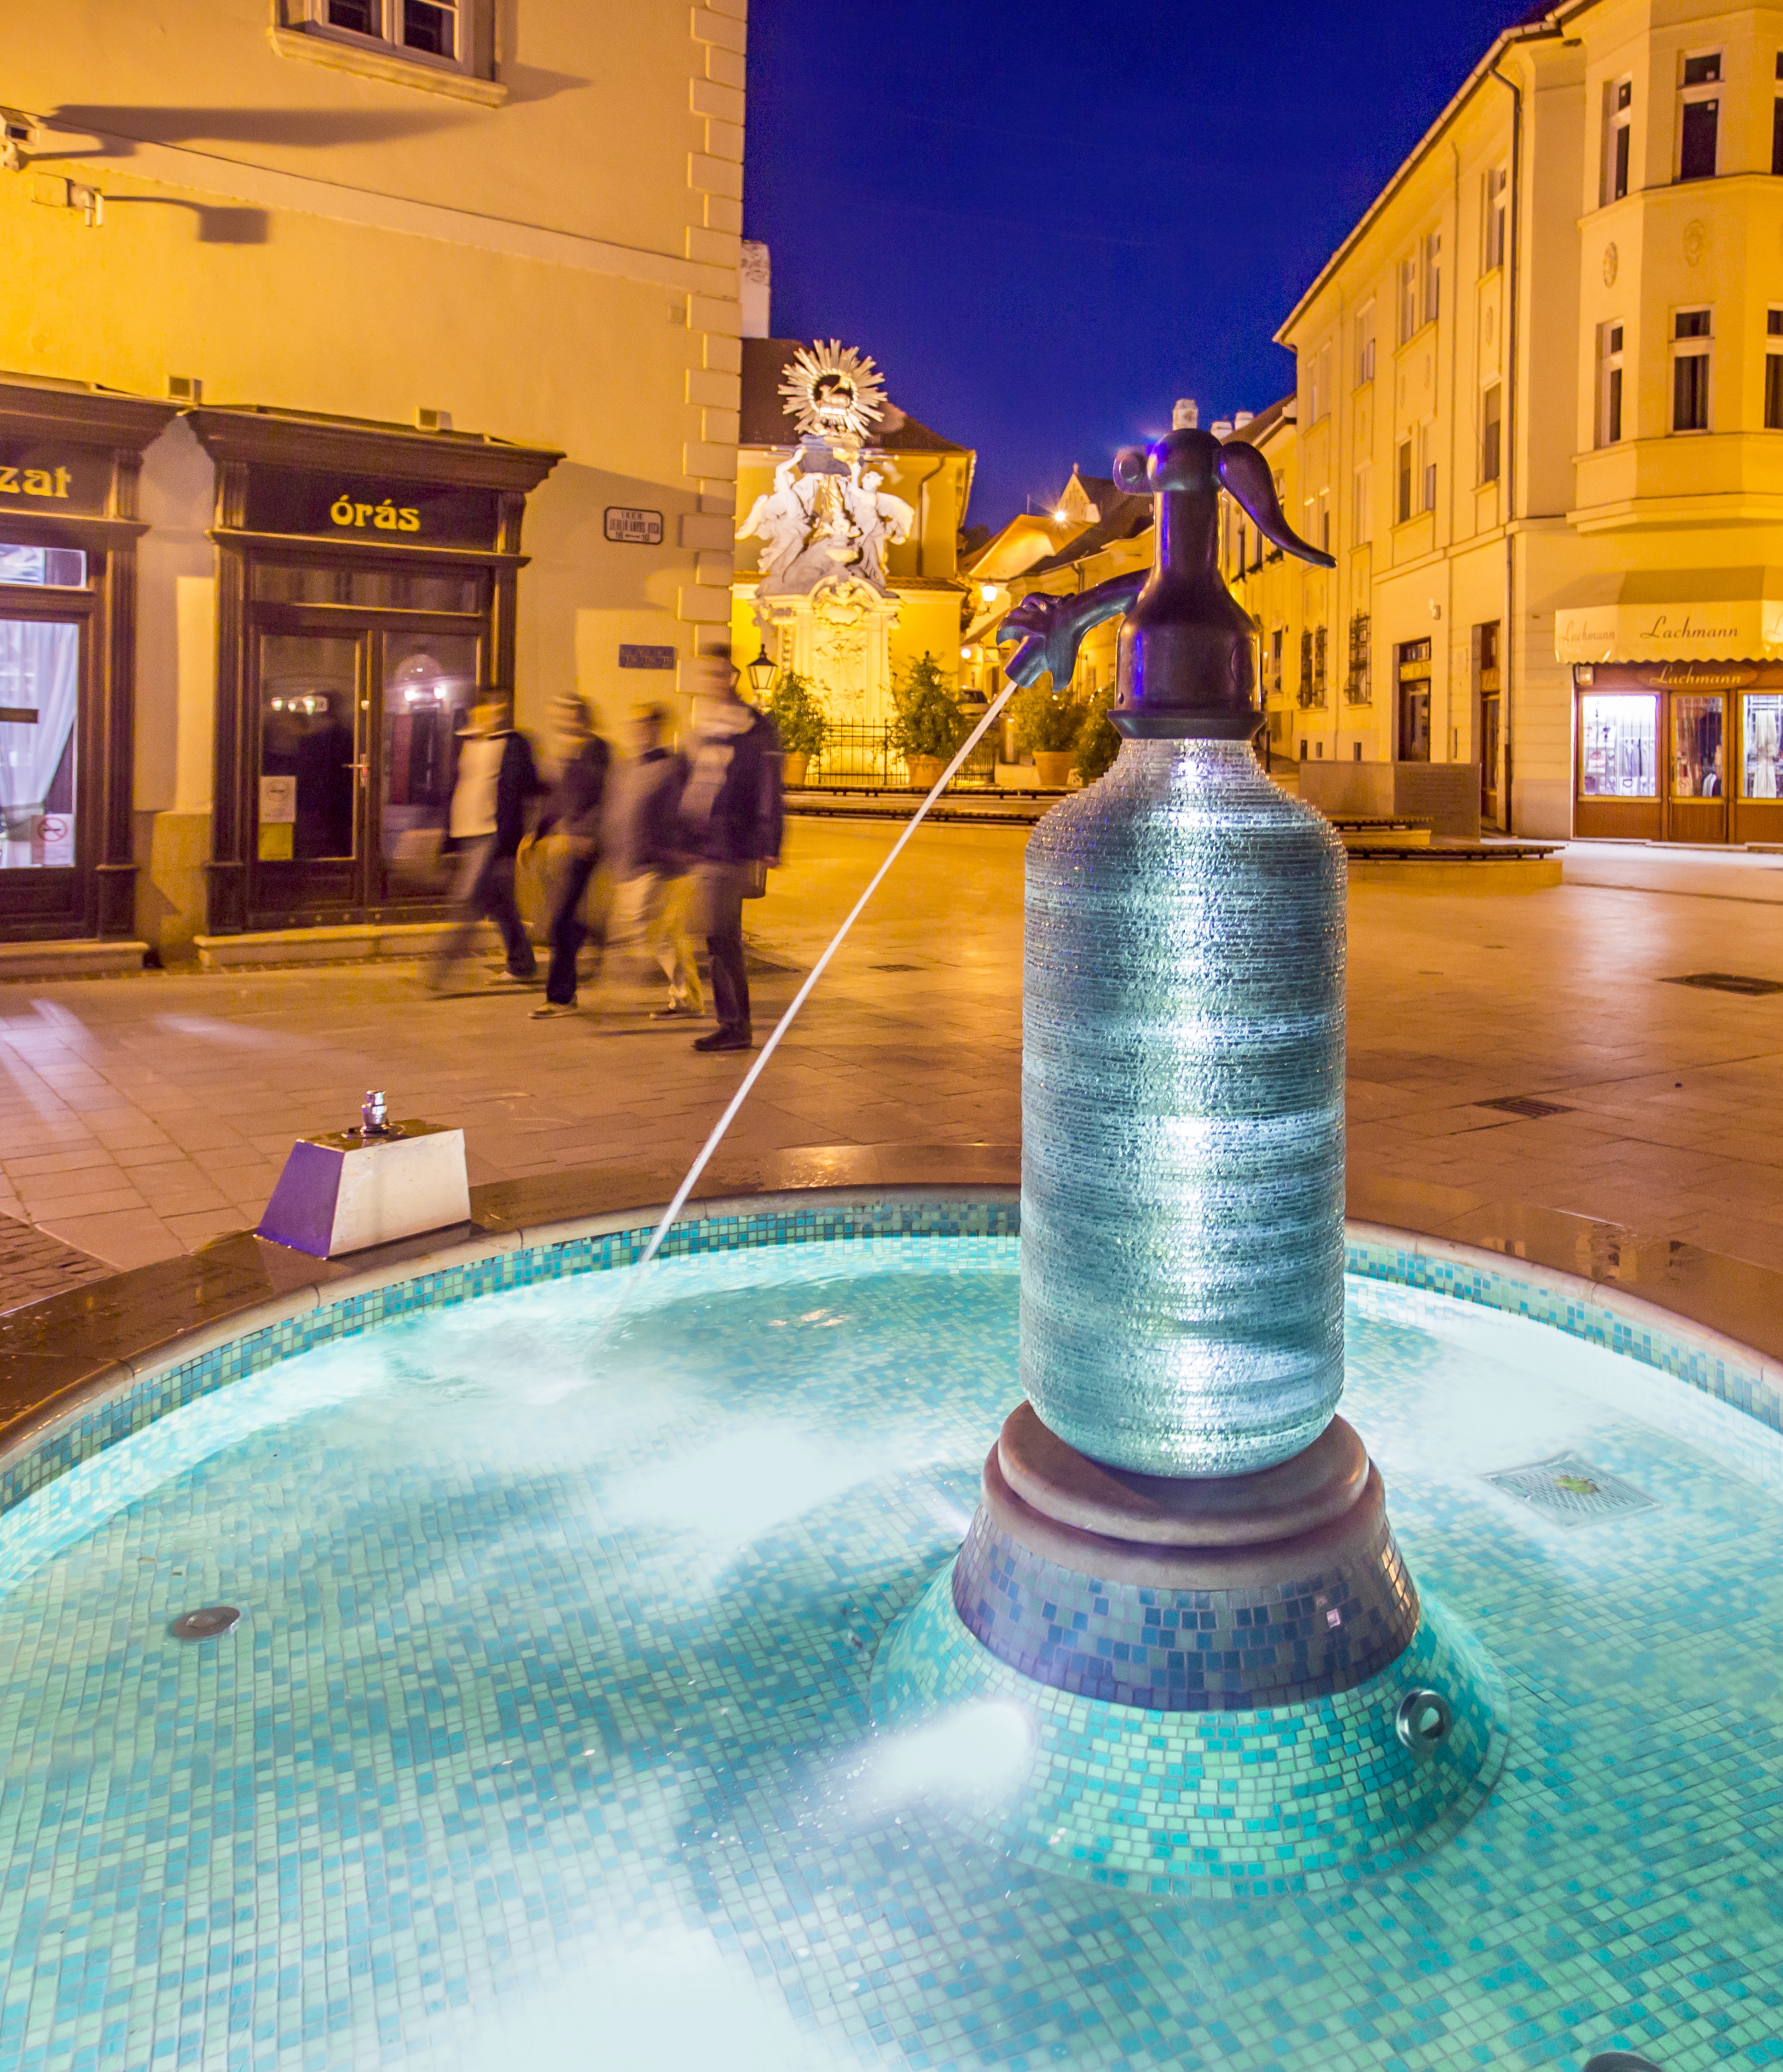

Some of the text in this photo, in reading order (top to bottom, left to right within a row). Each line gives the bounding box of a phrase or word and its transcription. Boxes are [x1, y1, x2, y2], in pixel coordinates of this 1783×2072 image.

[330, 494, 420, 531] órás
[1640, 615, 1739, 639] Lachmann
[1649, 664, 1741, 685] Lachmann
